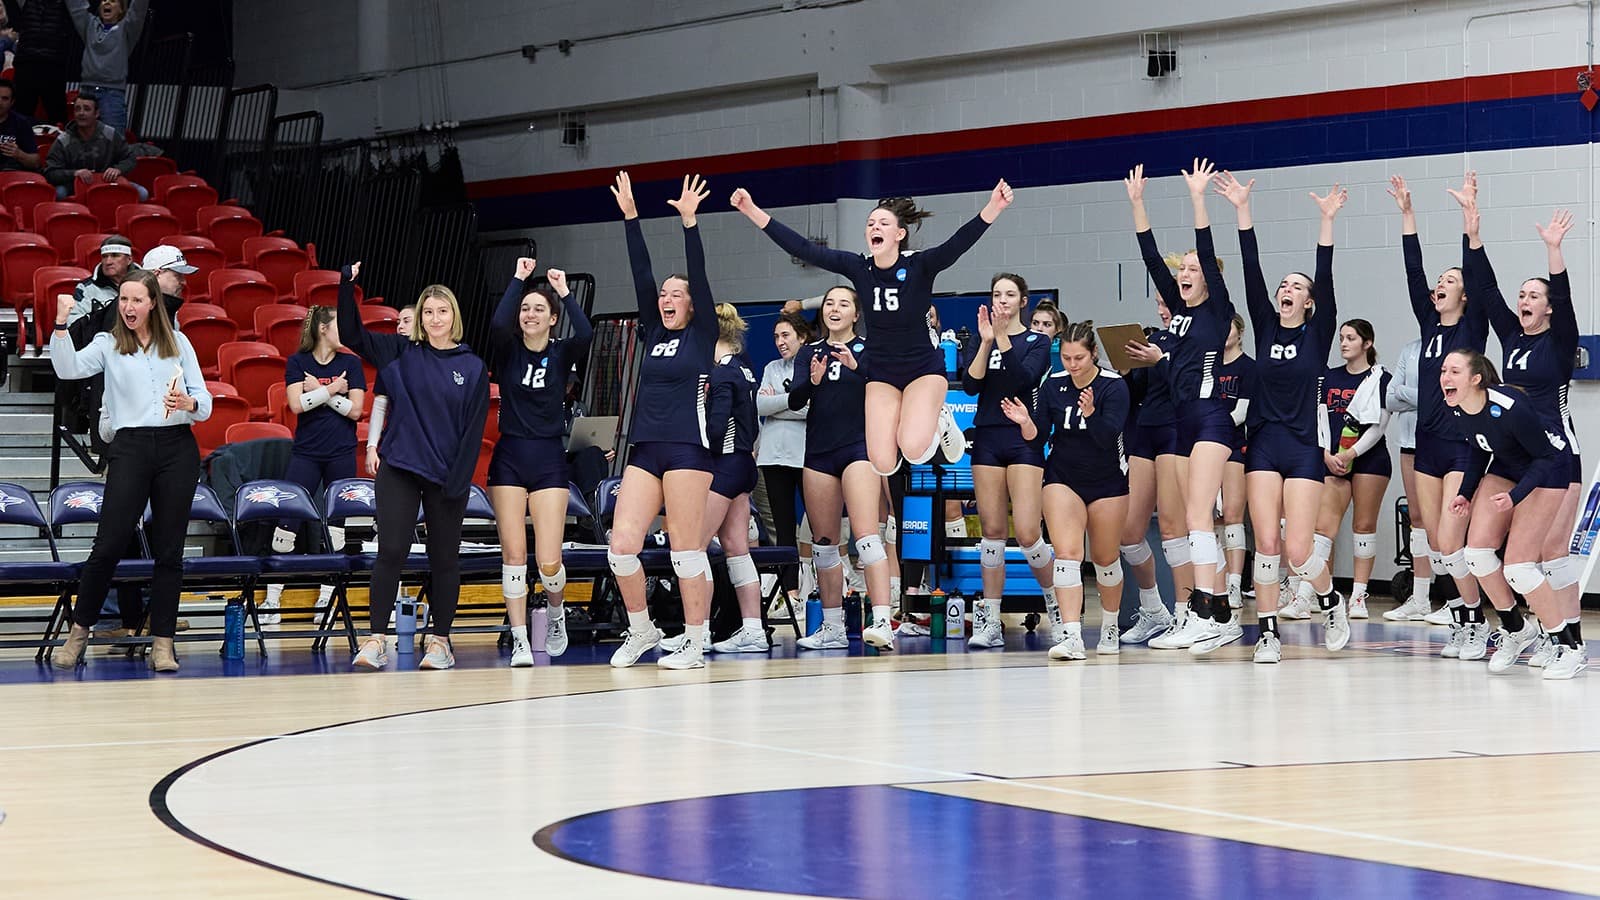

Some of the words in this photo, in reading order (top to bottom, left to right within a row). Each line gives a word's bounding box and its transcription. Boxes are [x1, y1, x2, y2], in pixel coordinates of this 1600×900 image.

[873, 287, 899, 311] 15
[1168, 315, 1193, 337] 20
[1425, 334, 1443, 358] 11
[989, 349, 1006, 370] 2
[1507, 348, 1532, 370] 14
[522, 363, 546, 389] 12
[828, 361, 841, 381] 3
